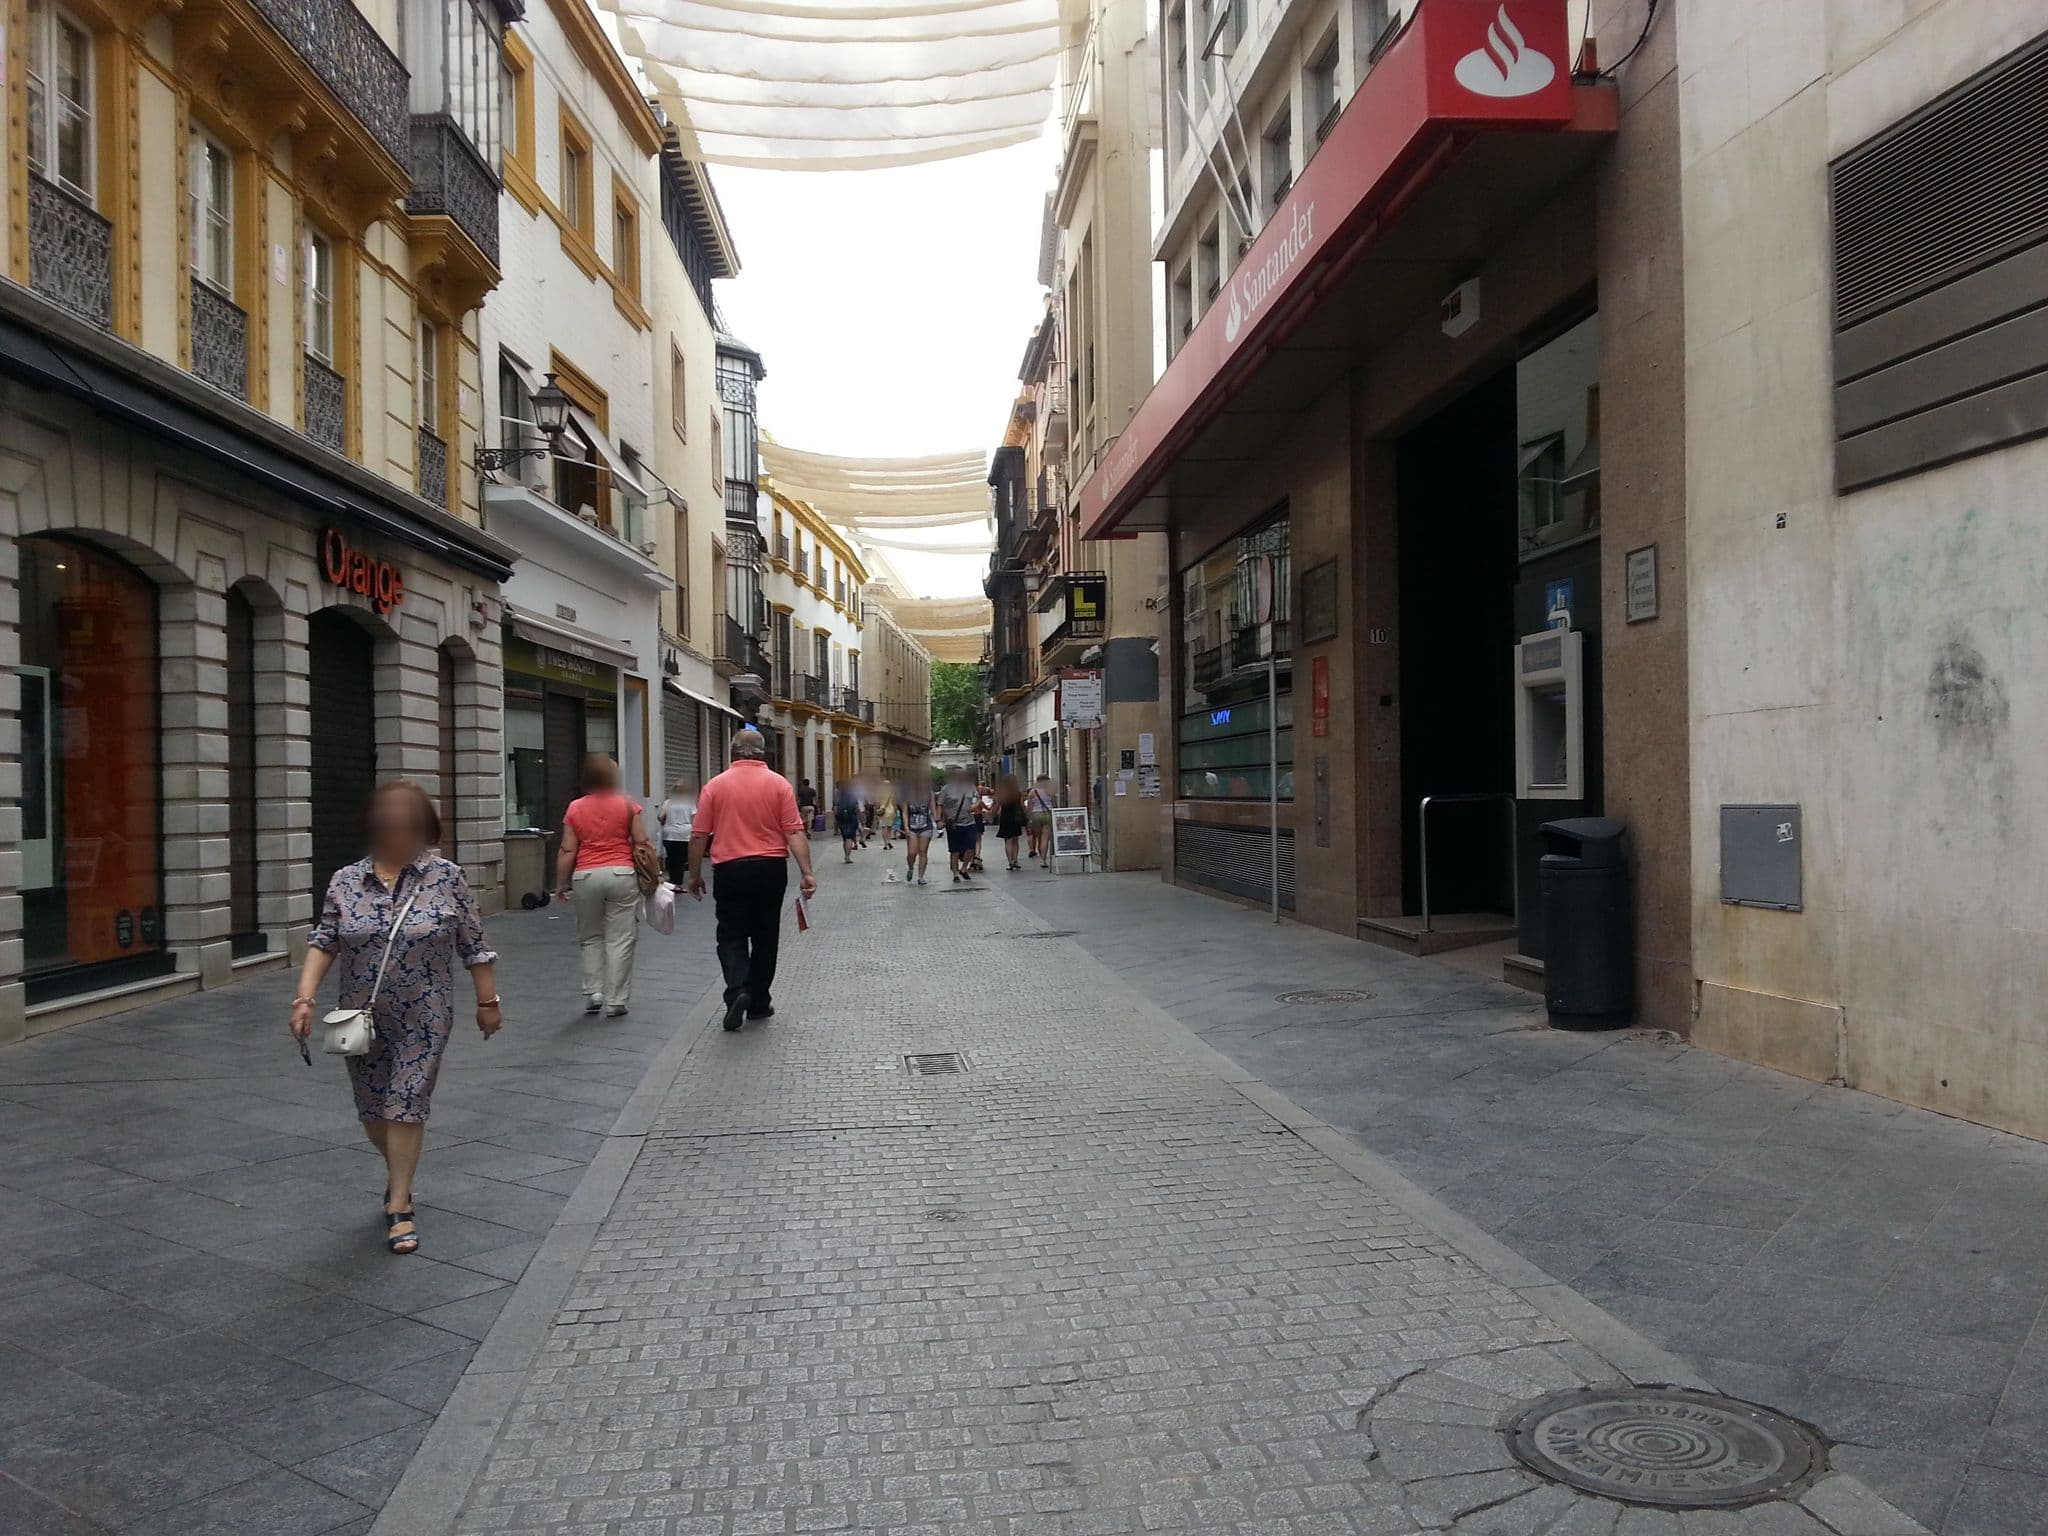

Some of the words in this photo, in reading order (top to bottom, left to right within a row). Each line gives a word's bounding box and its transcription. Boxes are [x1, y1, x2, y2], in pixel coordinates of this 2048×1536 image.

[1242, 201, 1314, 321] Santander
[325, 528, 404, 615] Orange
[1074, 587, 1096, 609] L
[1372, 629, 1385, 643] 10
